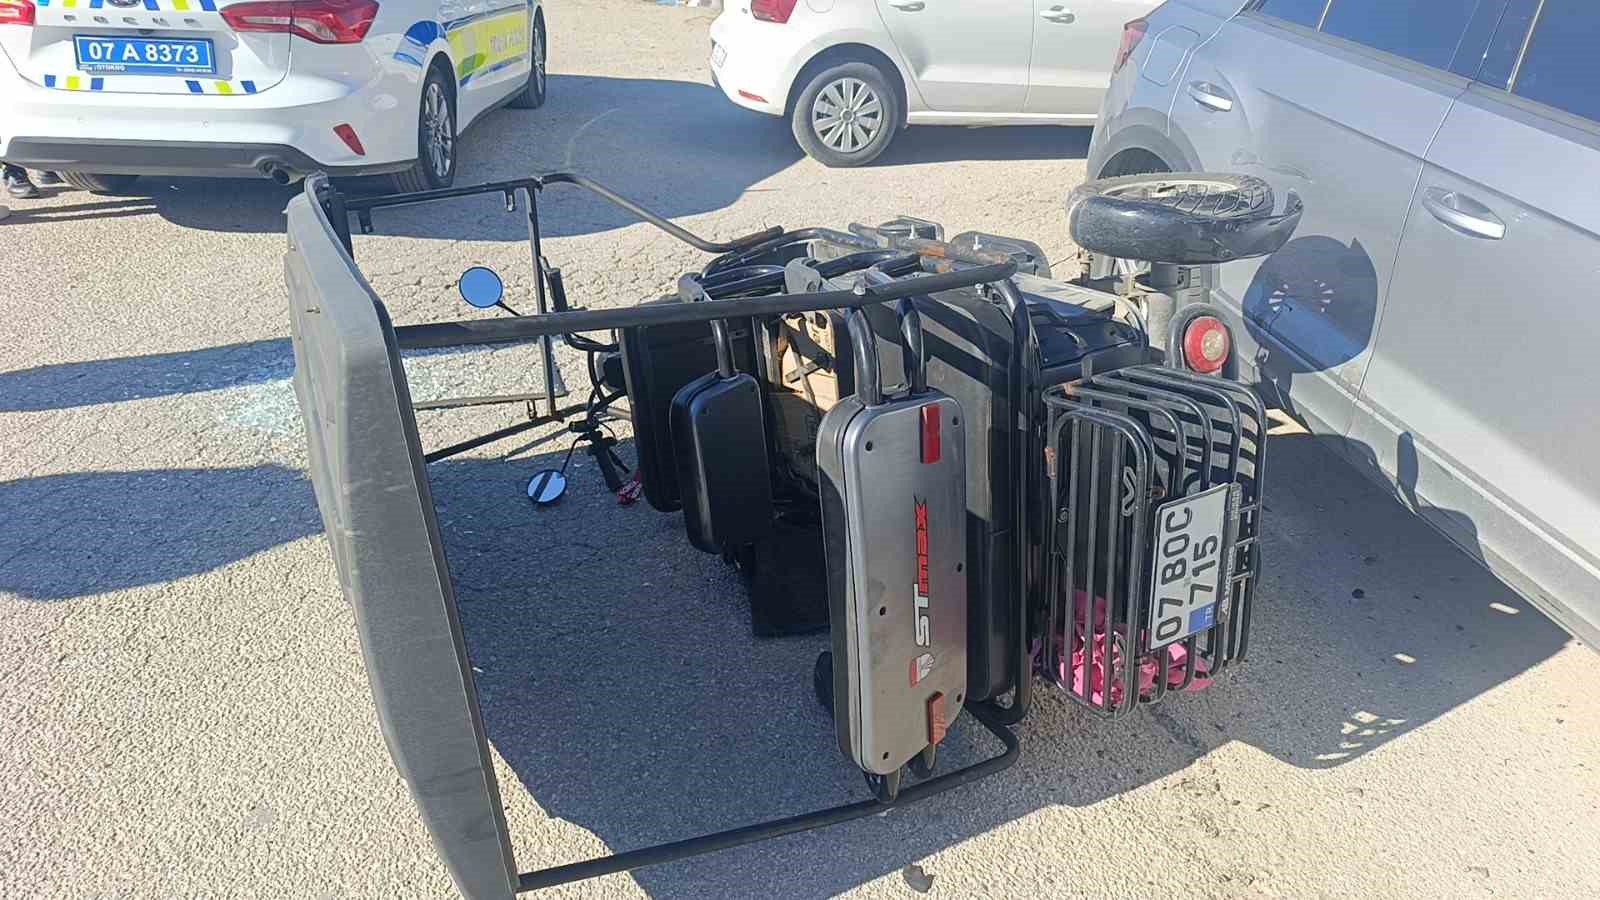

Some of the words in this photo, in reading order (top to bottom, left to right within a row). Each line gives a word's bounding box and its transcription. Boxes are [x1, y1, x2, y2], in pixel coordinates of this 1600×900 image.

[88, 41, 114, 60] 07
[122, 43, 140, 61] A
[145, 44, 199, 63] 8373
[1161, 507, 1192, 585] BOC
[1189, 535, 1218, 605] 715
[1155, 597, 1184, 641] 07
[1205, 605, 1215, 620] TR
